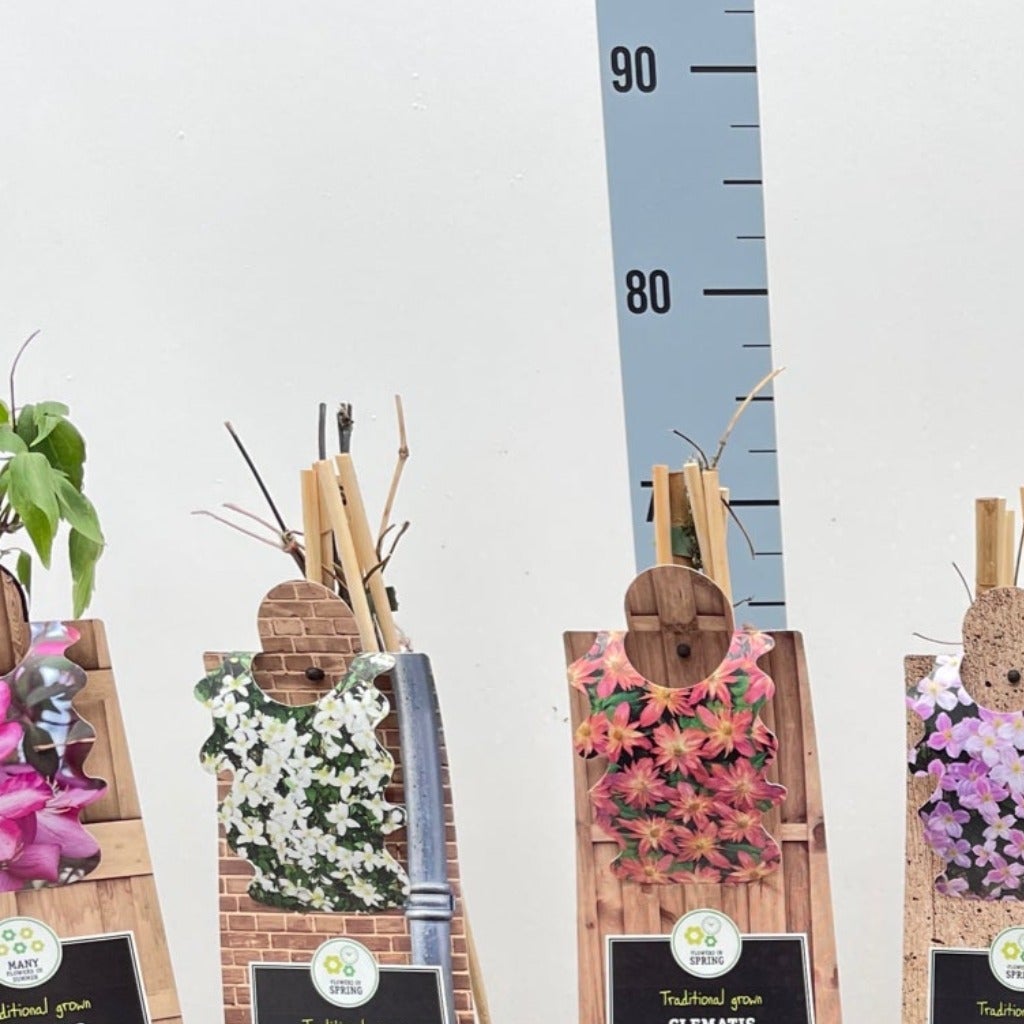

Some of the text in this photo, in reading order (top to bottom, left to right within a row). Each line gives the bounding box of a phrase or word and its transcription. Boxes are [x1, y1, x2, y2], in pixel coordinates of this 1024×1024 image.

[610, 46, 657, 93] 90
[626, 269, 671, 314] 80
[8, 958, 39, 970] MANY
[690, 956, 724, 966] SPRING
[329, 985, 363, 996] SPRING
[659, 988, 763, 1011] Traditional grown
[56, 999, 91, 1019] grown
